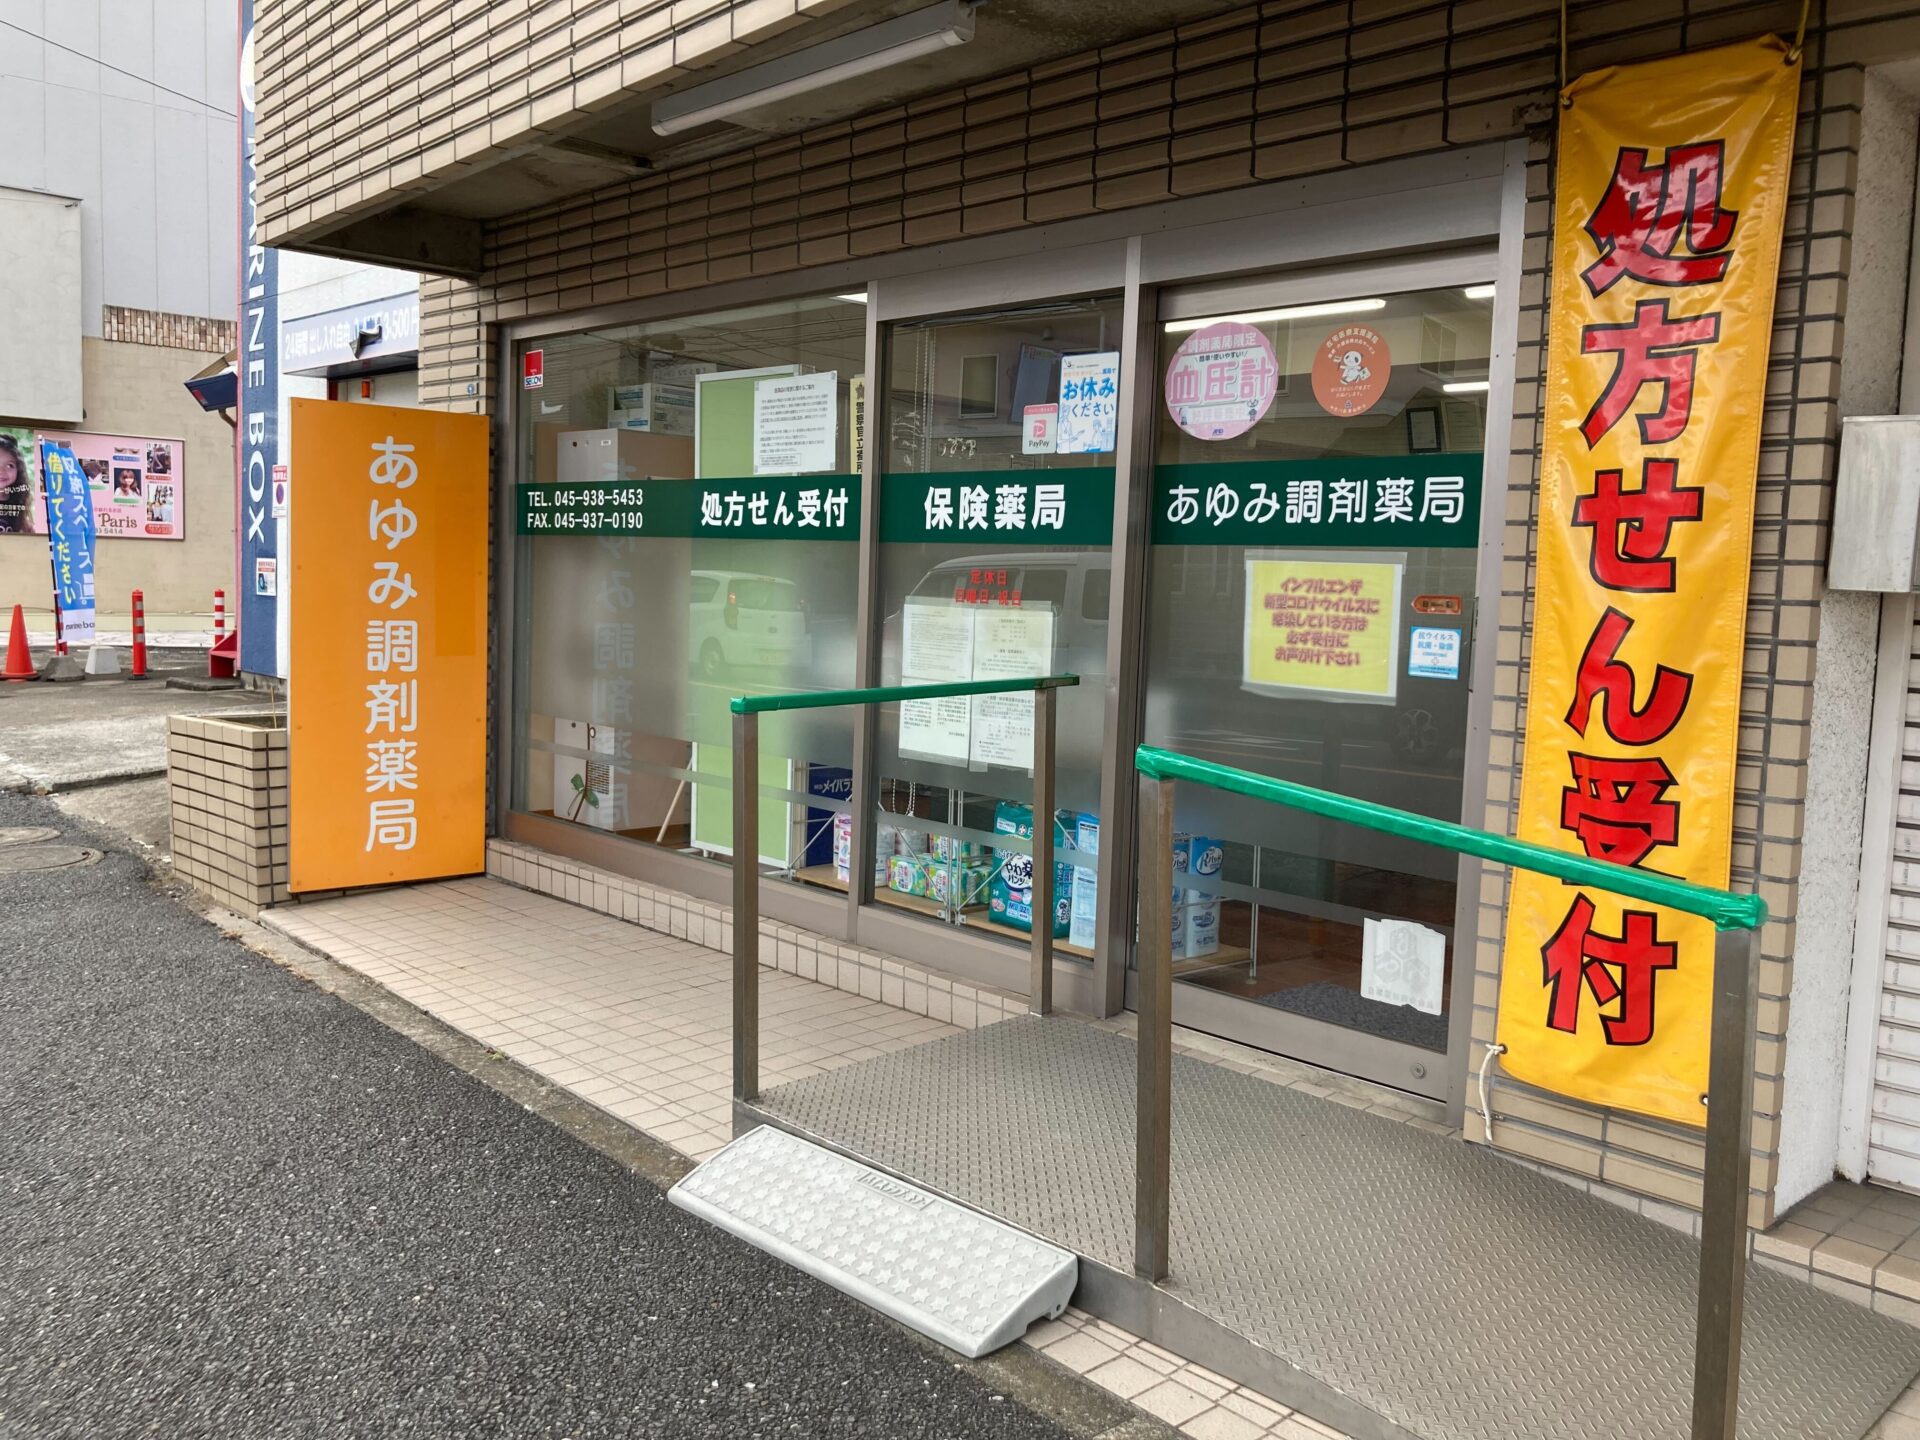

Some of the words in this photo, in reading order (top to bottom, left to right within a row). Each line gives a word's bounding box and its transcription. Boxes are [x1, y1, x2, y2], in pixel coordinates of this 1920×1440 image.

[1062, 376, 1116, 401] お休み
[1169, 355, 1275, 406] 血圧計
[1071, 402, 1115, 418] ください
[1028, 440, 1050, 450] PayPay
[248, 412, 265, 544] BOX
[528, 491, 552, 507] TEL.
[554, 489, 644, 507] 045-938-5453
[924, 484, 1066, 530] 保険薬局
[1166, 476, 1465, 527] あゆみ調剤薬局
[701, 488, 849, 528] 処方せん受付
[47, 451, 76, 605] 借りてください
[99, 512, 138, 528] Paris
[527, 513, 552, 529] FAX.
[554, 512, 644, 529] 045-937-0190
[970, 568, 1008, 585] 定休日
[1280, 577, 1364, 595] インフルエンザ
[954, 588, 1022, 607] 日曜日・祝日
[1541, 138, 1738, 1046] 処方せん受付
[1263, 594, 1381, 614] 新型コロナウイルスに
[1272, 612, 1369, 631] 感染している方は
[365, 435, 419, 853] あゆみ調剤薬局
[1286, 630, 1349, 648] 必ず受付に
[1418, 631, 1454, 641] 抗ウイルス
[1274, 646, 1360, 666] お声がけ下さい
